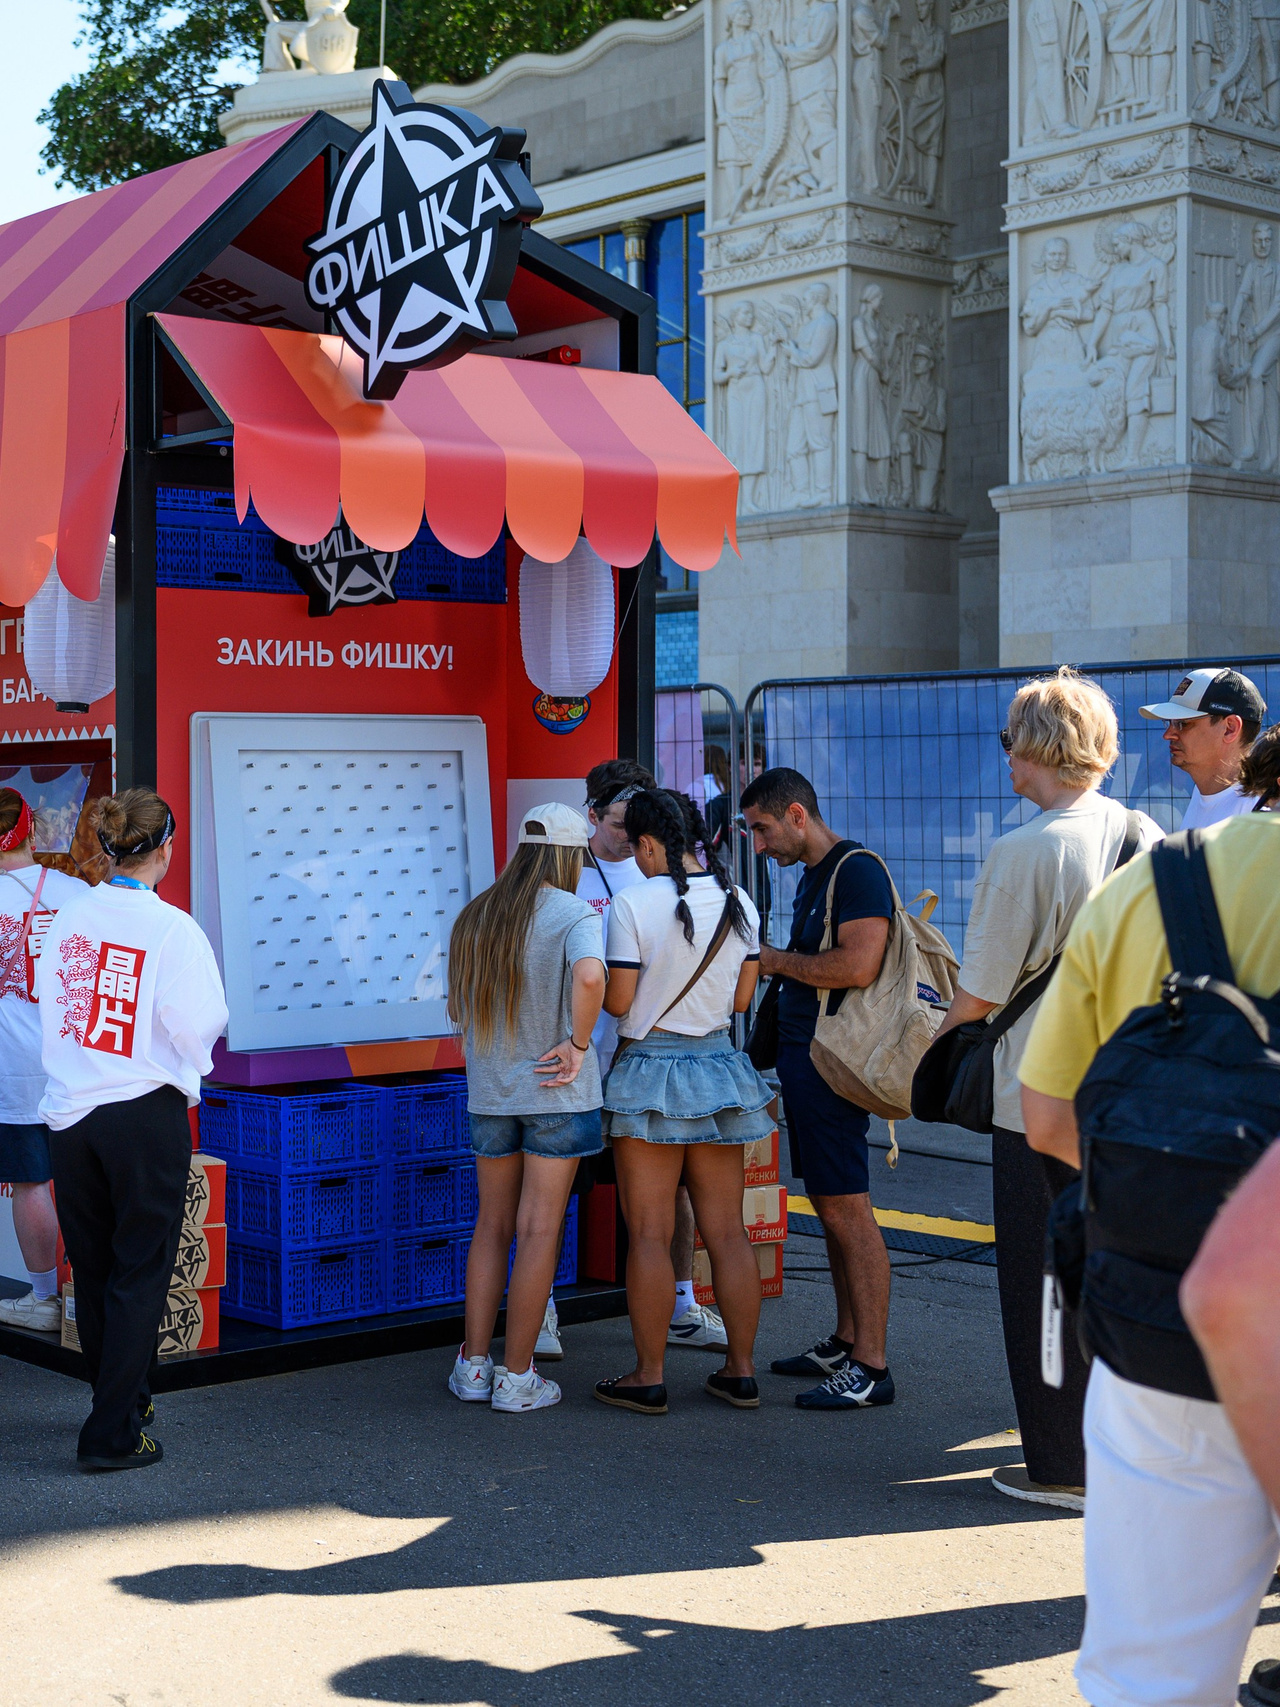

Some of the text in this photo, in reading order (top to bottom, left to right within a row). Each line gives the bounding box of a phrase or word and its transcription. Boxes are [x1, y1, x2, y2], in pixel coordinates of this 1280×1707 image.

[308, 163, 515, 309] ФИШКА
[295, 528, 375, 563] ФИШ
[217, 637, 453, 670] ЗАКИНЬ ФИШКУ!
[3, 677, 53, 705] БАР
[87, 948, 139, 1051] 晶片
[745, 1171, 776, 1183] ГРЕНКИ
[751, 1228, 784, 1240] ГРЕНКИ
[159, 1309, 199, 1333] ШКА
